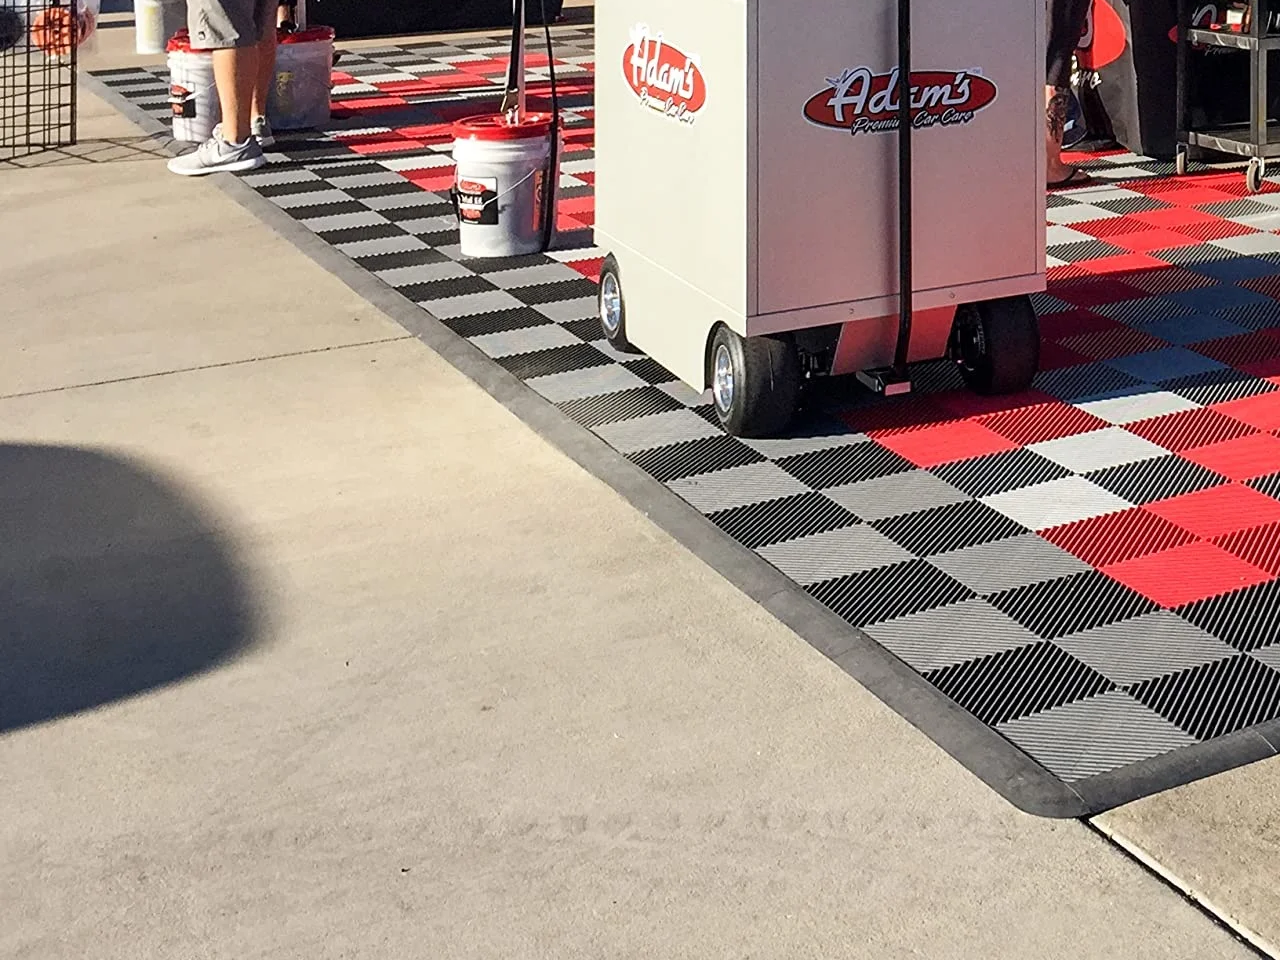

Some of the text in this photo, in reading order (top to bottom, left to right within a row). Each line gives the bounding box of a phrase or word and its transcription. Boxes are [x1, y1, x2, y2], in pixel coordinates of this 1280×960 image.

[629, 24, 694, 100] Adam's
[852, 108, 972, 137] Premiu Car Care
